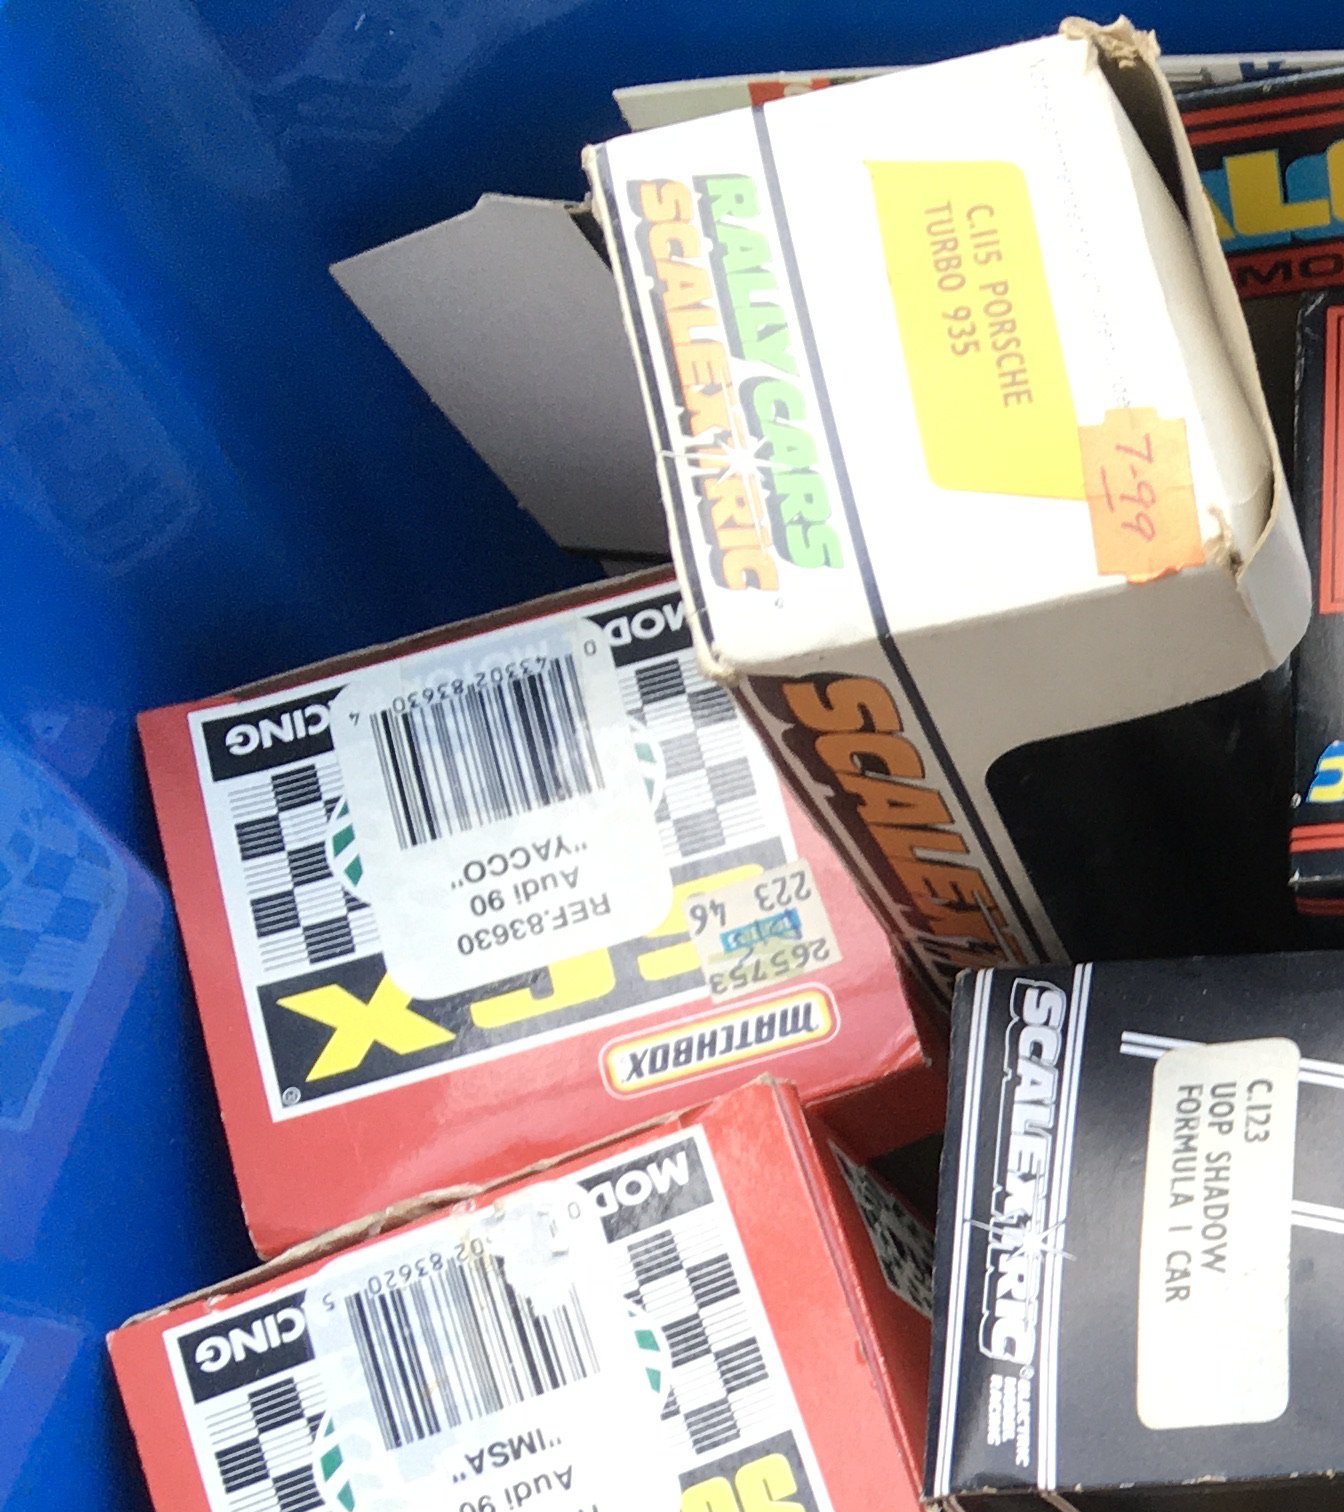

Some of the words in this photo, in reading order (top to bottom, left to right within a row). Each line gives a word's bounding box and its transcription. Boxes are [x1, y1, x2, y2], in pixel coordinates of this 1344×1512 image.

[966, 203, 1004, 271] C.115
[923, 202, 964, 295] TURBO
[947, 301, 982, 357] 935
[693, 172, 794, 376] RALLY
[753, 376, 843, 570] CARS
[982, 280, 1033, 408] PORSCHE
[627, 177, 779, 592] SCALEXTRIC
[469, 891, 506, 918] 90
[509, 864, 580, 908] Audi
[755, 871, 809, 910] 223
[457, 891, 611, 958] REF.83630
[621, 999, 821, 1085] MATCHBOX
[1210, 1082, 1236, 1136] UOP
[1244, 1078, 1273, 1144] C.123
[979, 977, 1067, 1365] SCALEXTRIC
[1169, 1084, 1202, 1210] FORMULA
[1200, 1150, 1232, 1274] SHADOW
[1164, 1250, 1191, 1304] CAR
[498, 1462, 575, 1512] Audi
